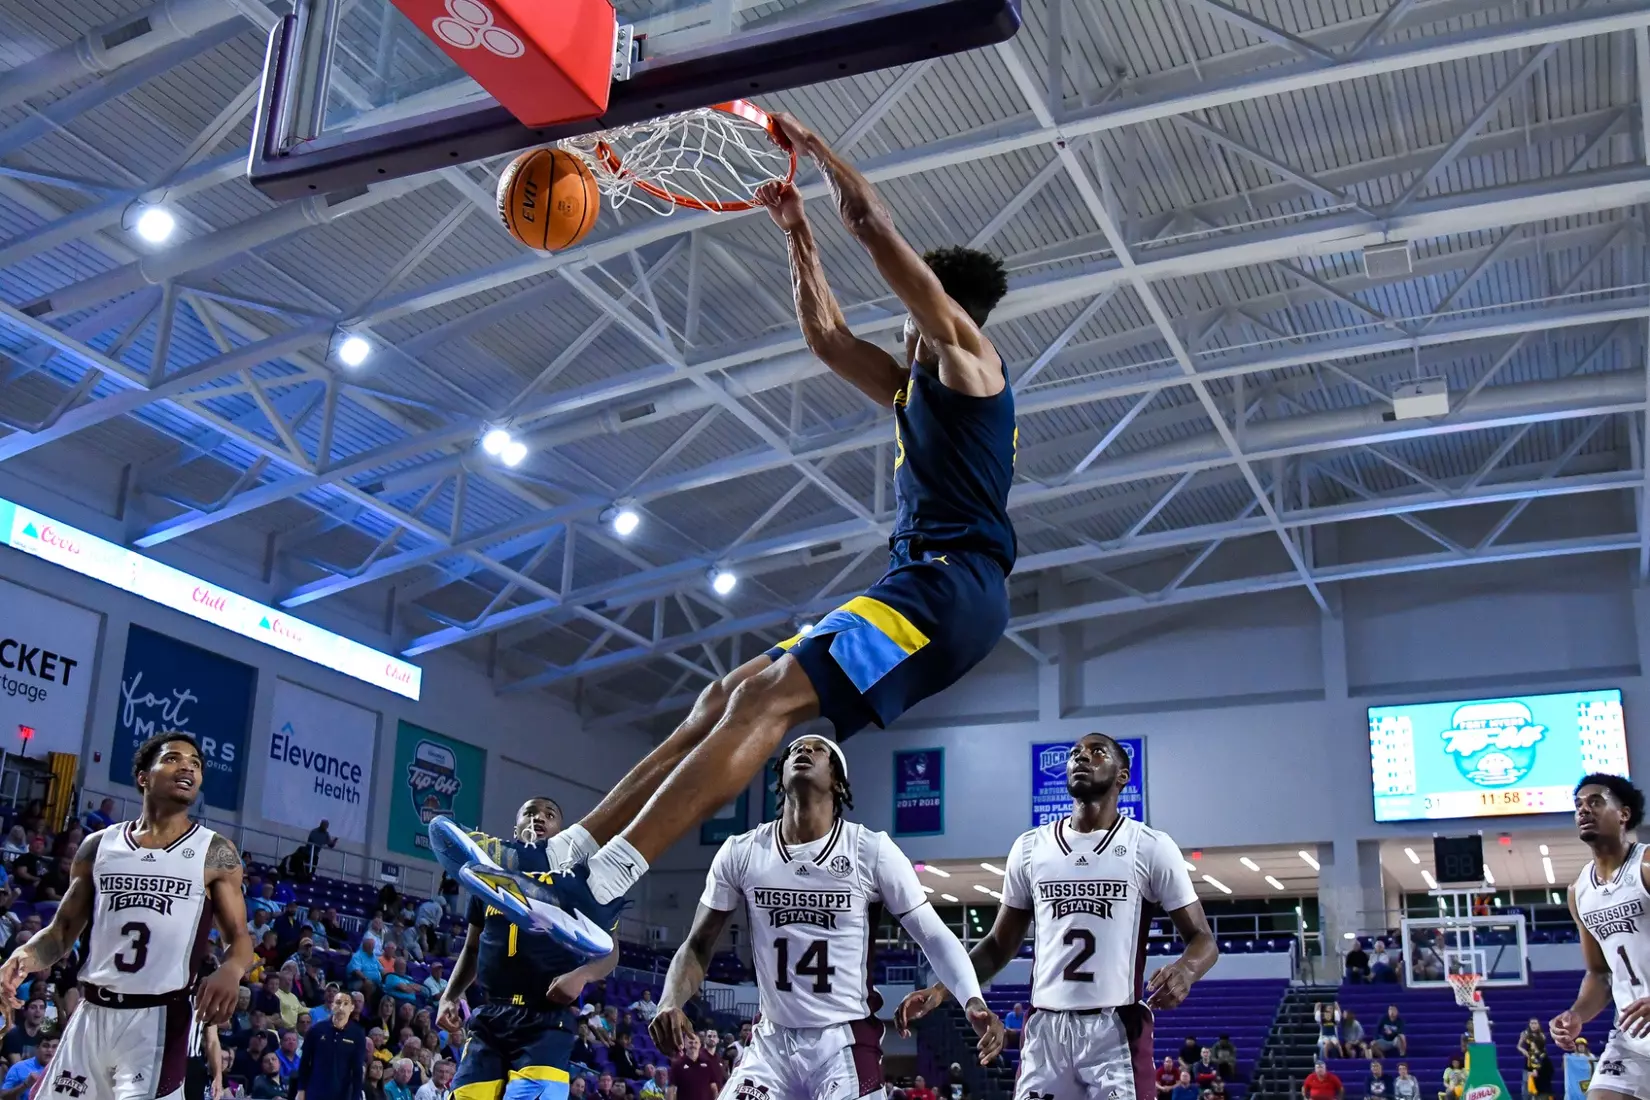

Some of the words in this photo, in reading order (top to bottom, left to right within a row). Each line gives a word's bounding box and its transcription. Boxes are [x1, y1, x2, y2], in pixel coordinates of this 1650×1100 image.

[192, 586, 226, 612] Chill
[0, 638, 78, 686] CKET
[385, 662, 411, 684] Chill
[0, 674, 47, 702] tgage
[134, 717, 236, 762] MYRS
[270, 733, 362, 784] Elevance
[314, 776, 360, 804] Health
[1480, 791, 1521, 805] 11:58
[1052, 803, 1073, 812] PLAC
[100, 876, 192, 897] MISSISSIPPI
[754, 890, 851, 908] MISSISSIPPI
[1039, 883, 1128, 898] MISSISSIPPI
[119, 894, 162, 909] STATE
[1060, 902, 1101, 914] STATE
[780, 910, 824, 925] STATE
[1583, 902, 1643, 927] MISSISSIPPI
[1601, 922, 1630, 937] STATE
[114, 921, 150, 973] 3
[1063, 928, 1096, 982] 2
[773, 937, 836, 993] 14
[1616, 944, 1641, 986] 1
